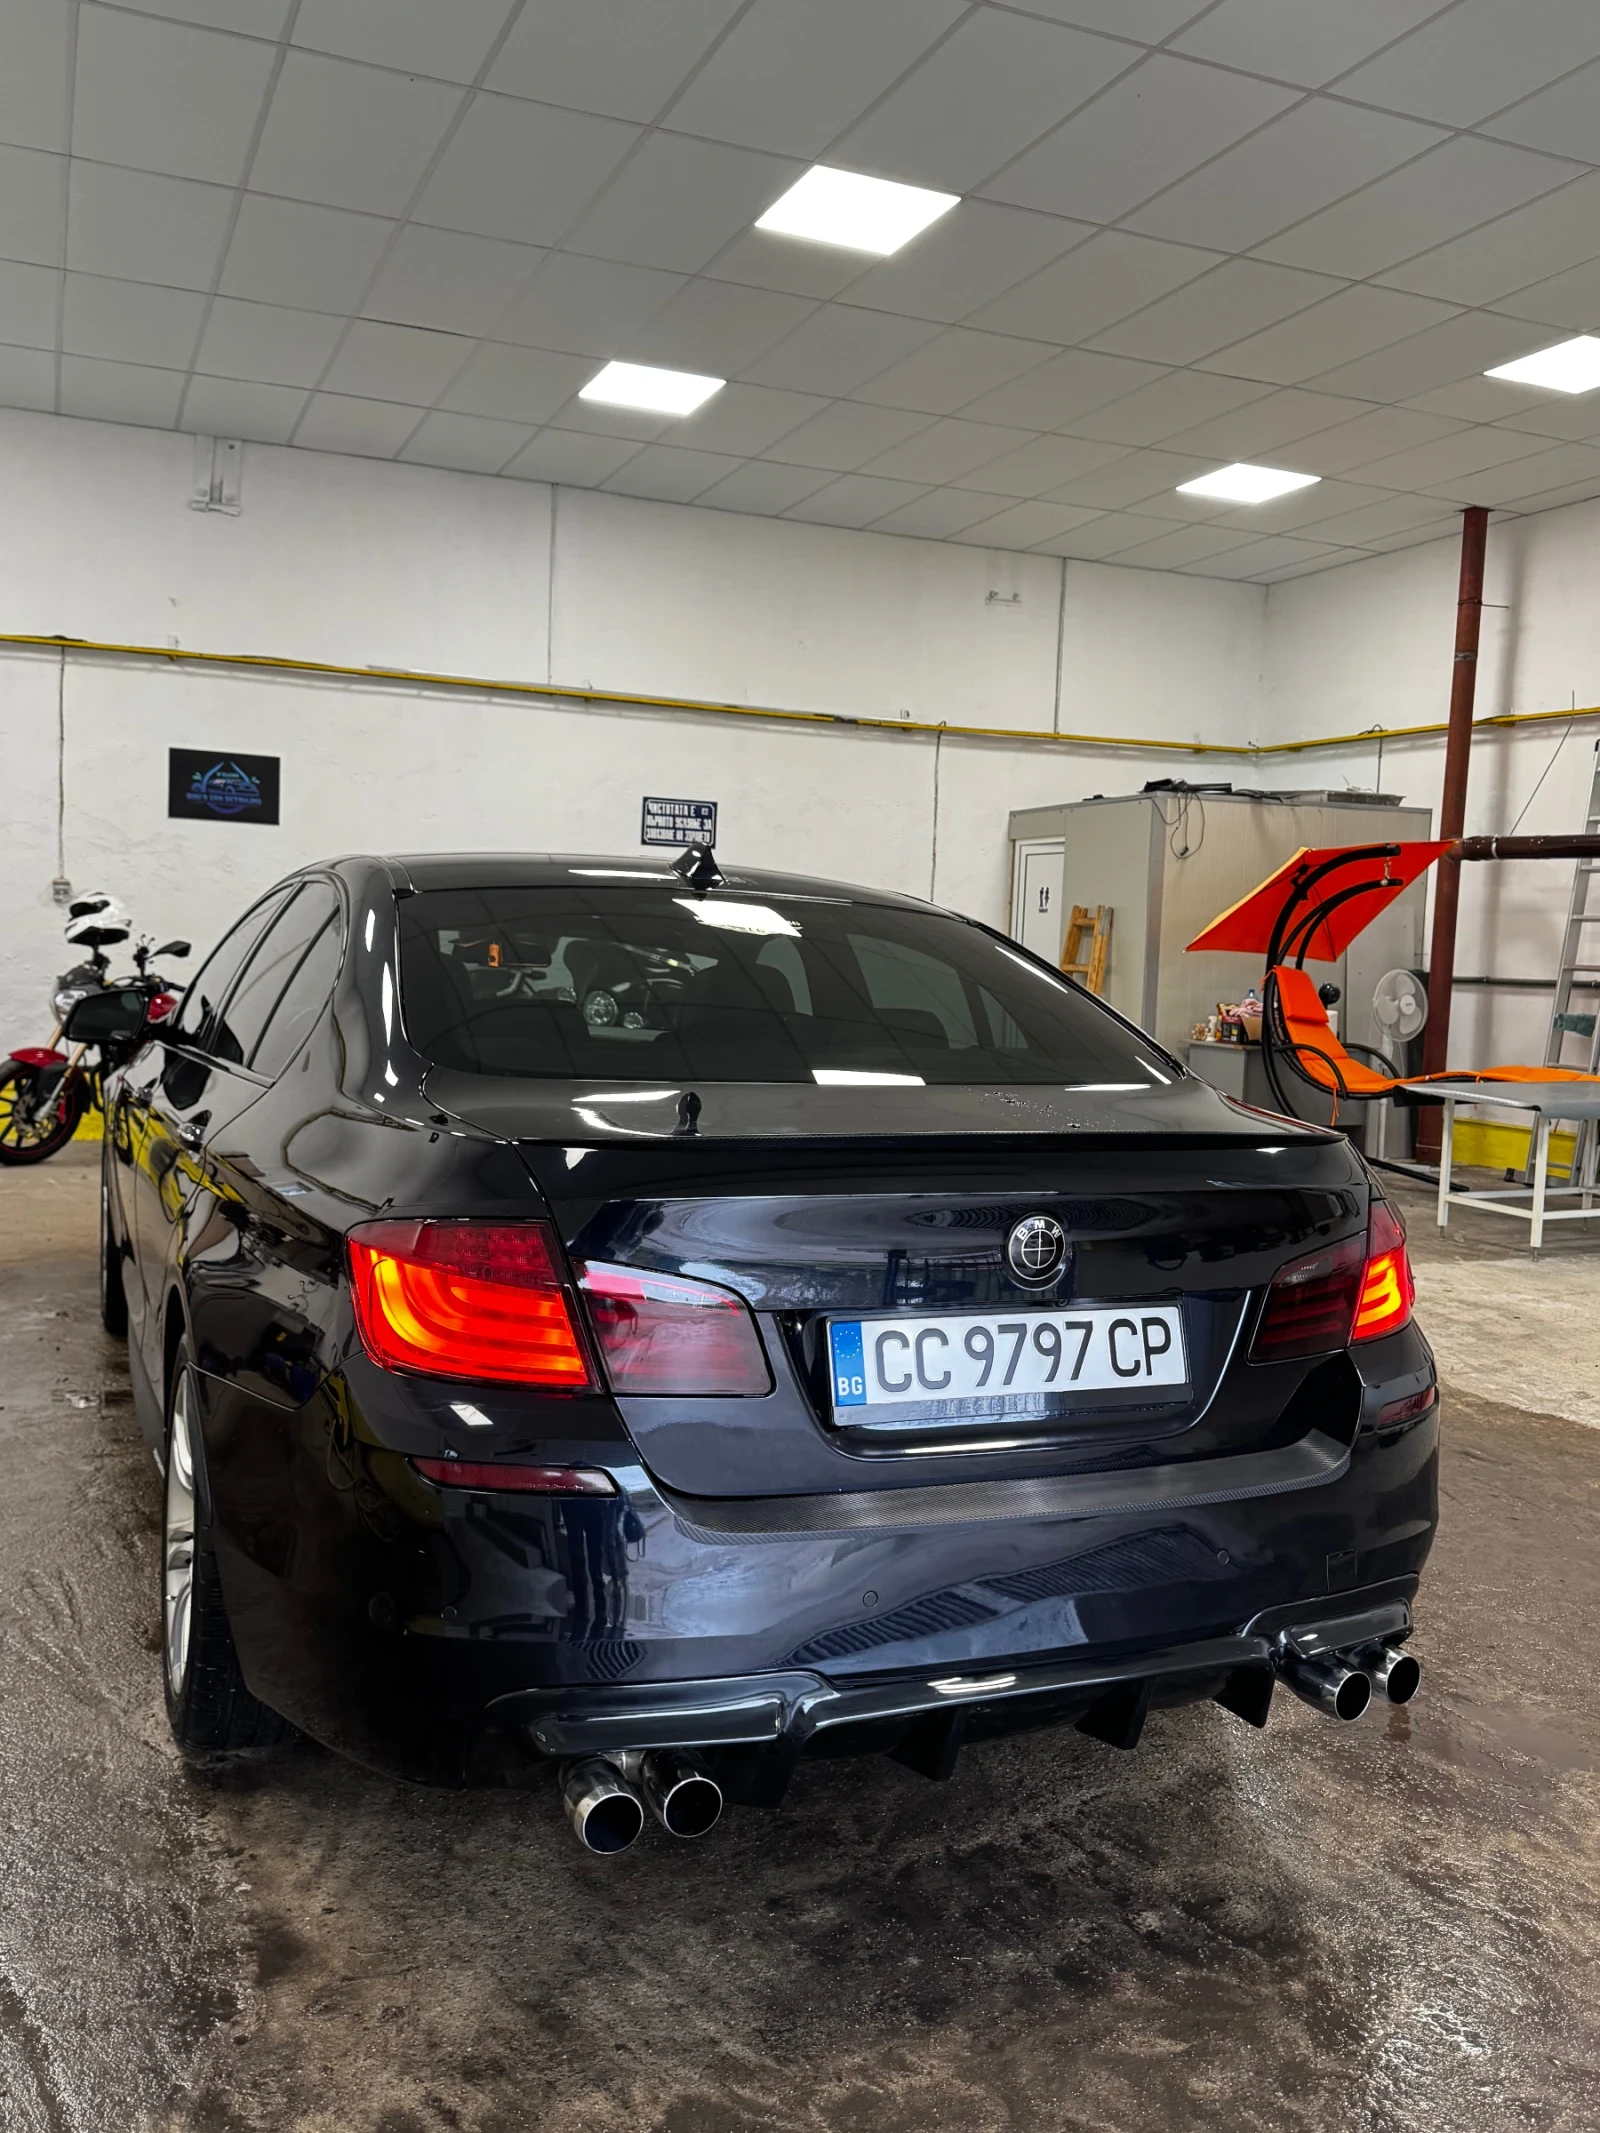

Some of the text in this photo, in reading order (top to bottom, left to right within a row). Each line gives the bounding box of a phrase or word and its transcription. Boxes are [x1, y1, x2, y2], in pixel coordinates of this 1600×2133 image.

[648, 803, 688, 816] ЧИСТОТАТА
[1016, 1219, 1062, 1241] BMW
[964, 1320, 1093, 1387] 9797
[837, 1375, 863, 1397] BG
